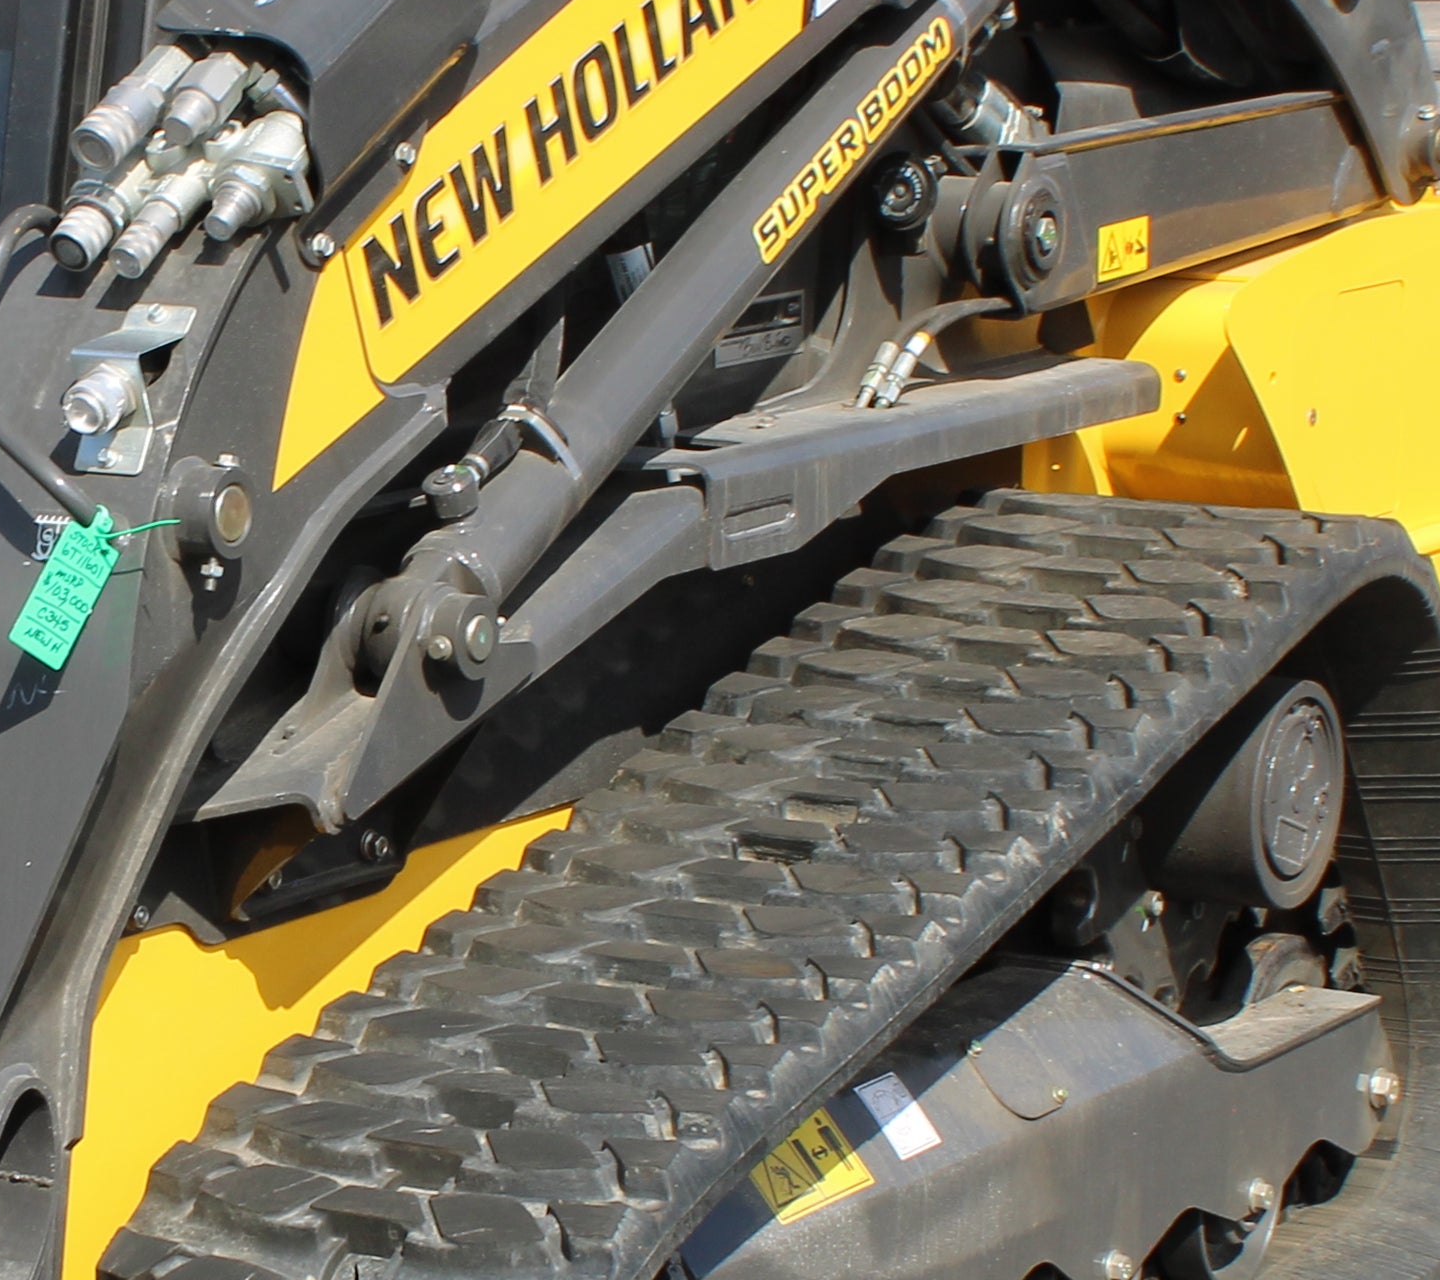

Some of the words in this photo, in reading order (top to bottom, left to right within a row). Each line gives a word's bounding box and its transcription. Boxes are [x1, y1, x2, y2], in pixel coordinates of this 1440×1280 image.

[361, 121, 515, 330] NEW
[756, 120, 862, 254] SUPER
[858, 19, 948, 137] BOOM
